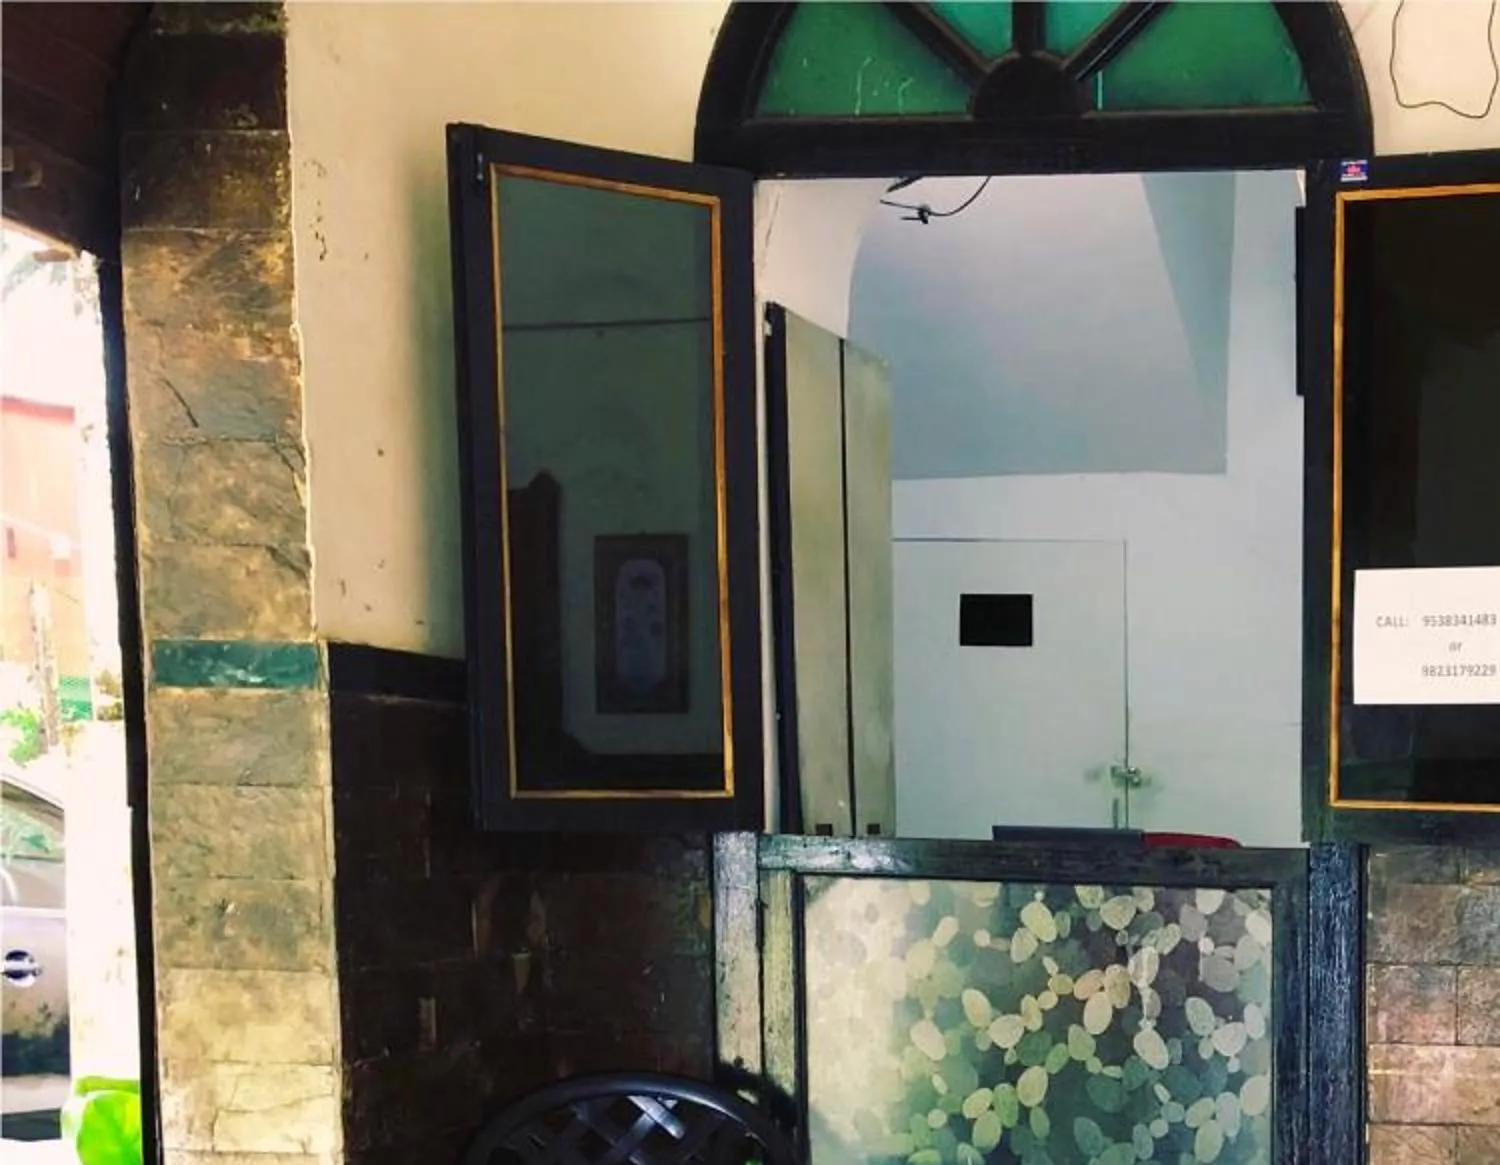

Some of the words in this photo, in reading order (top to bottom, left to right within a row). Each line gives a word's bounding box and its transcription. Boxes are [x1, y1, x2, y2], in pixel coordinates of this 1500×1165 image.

[1376, 615, 1408, 628] CALL:
[1422, 614, 1497, 627] 9538341483
[1448, 642, 1463, 652] or
